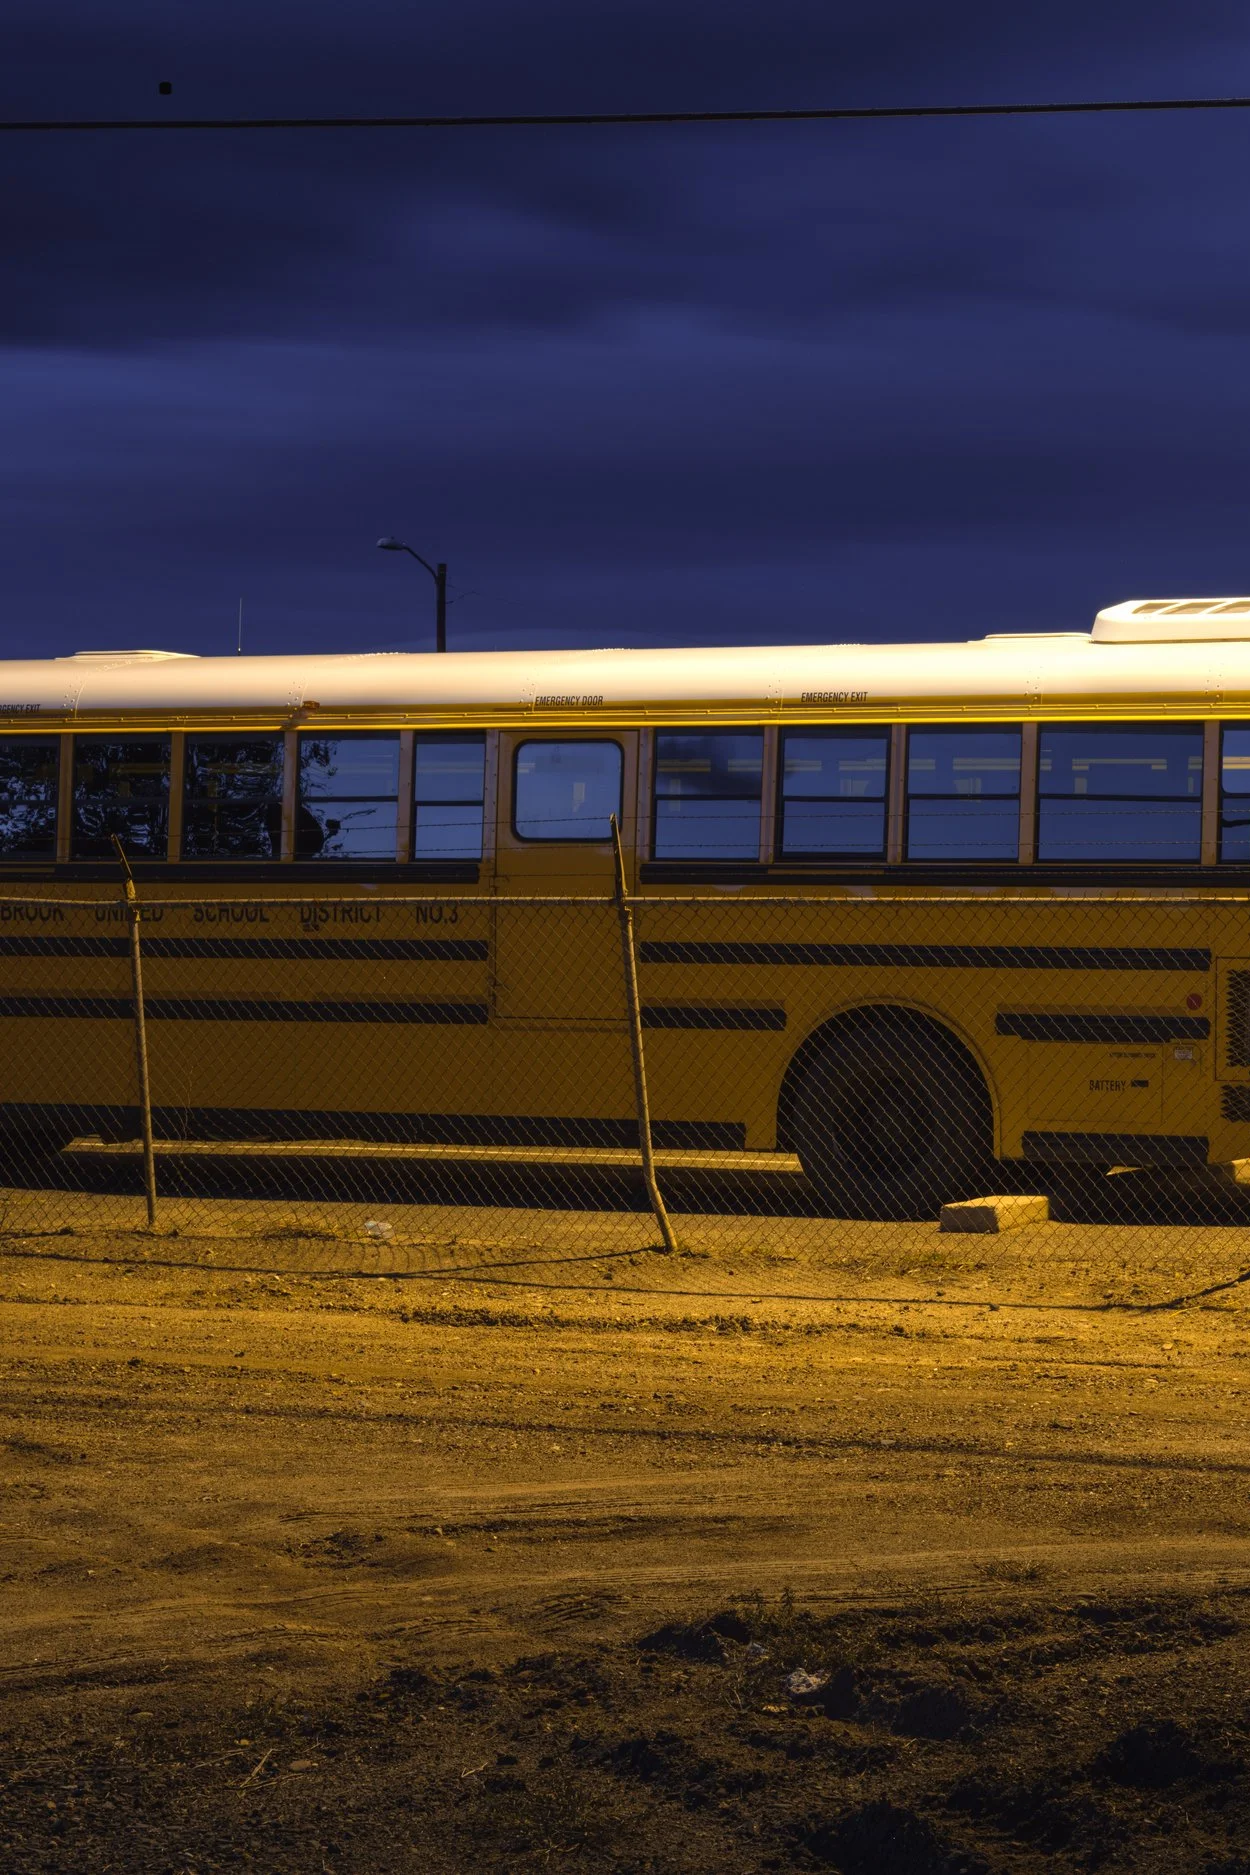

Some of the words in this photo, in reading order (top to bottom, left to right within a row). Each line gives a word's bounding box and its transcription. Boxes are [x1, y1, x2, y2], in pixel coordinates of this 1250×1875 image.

[535, 696, 580, 706] EMERGENCY
[582, 696, 603, 706] DOOR
[801, 692, 849, 703] EMERGENCY
[851, 692, 868, 702] EXIT
[26, 704, 40, 713] EXIT
[194, 906, 269, 922] SCHOOL
[301, 906, 380, 923] DISTRICT
[1089, 1080, 1125, 1091] BATTERY
